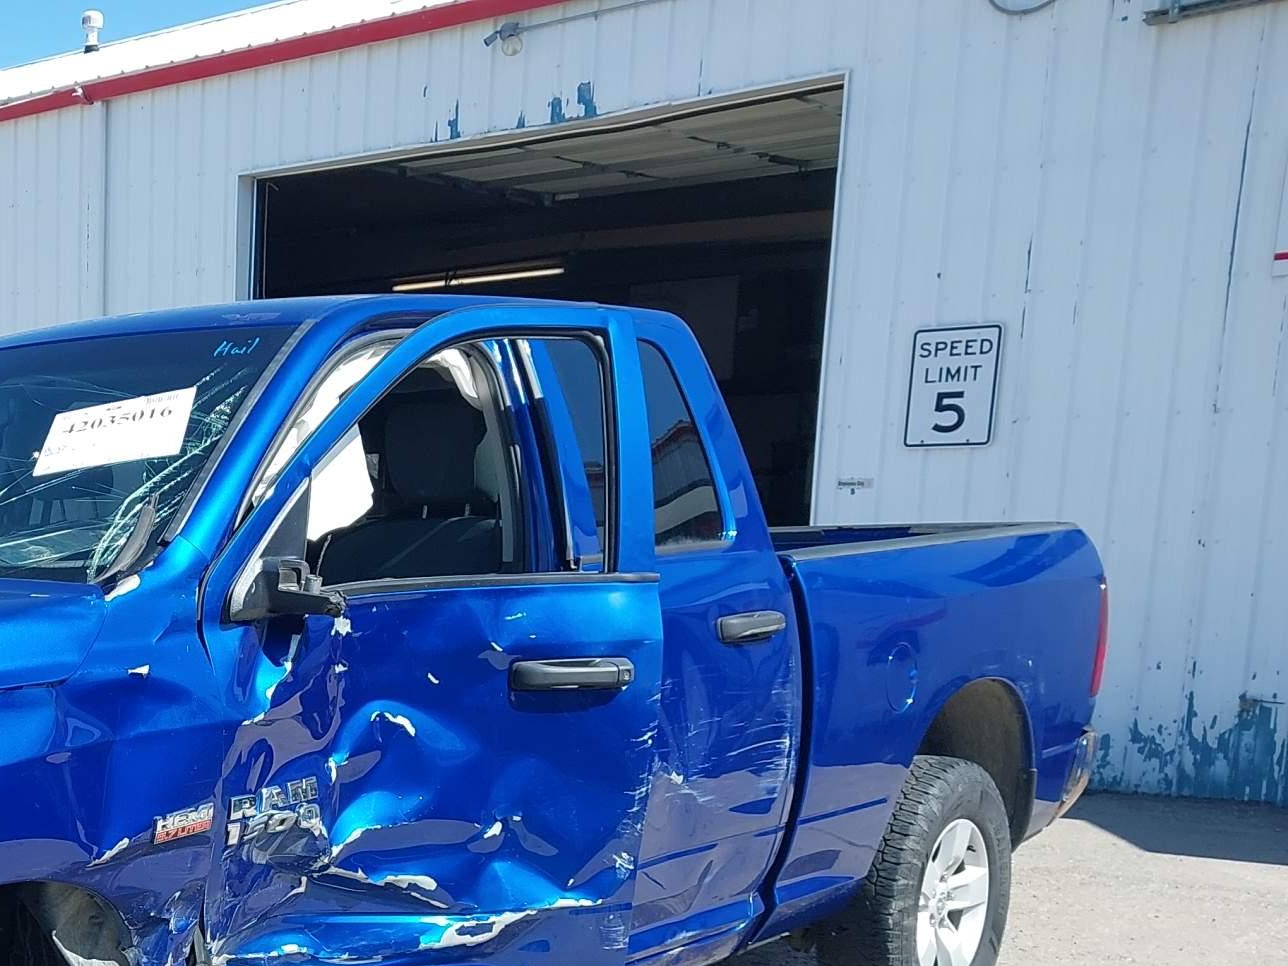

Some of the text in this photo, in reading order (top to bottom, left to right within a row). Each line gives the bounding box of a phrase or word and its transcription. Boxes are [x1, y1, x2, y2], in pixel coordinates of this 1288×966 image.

[213, 336, 260, 357] Hail
[919, 338, 994, 358] SPEED
[924, 365, 983, 384] LIMIT
[62, 407, 173, 435] 42035016
[931, 390, 966, 433] 5
[228, 776, 318, 820] RAM
[155, 802, 213, 834] HEMI
[225, 803, 320, 847] 1500
